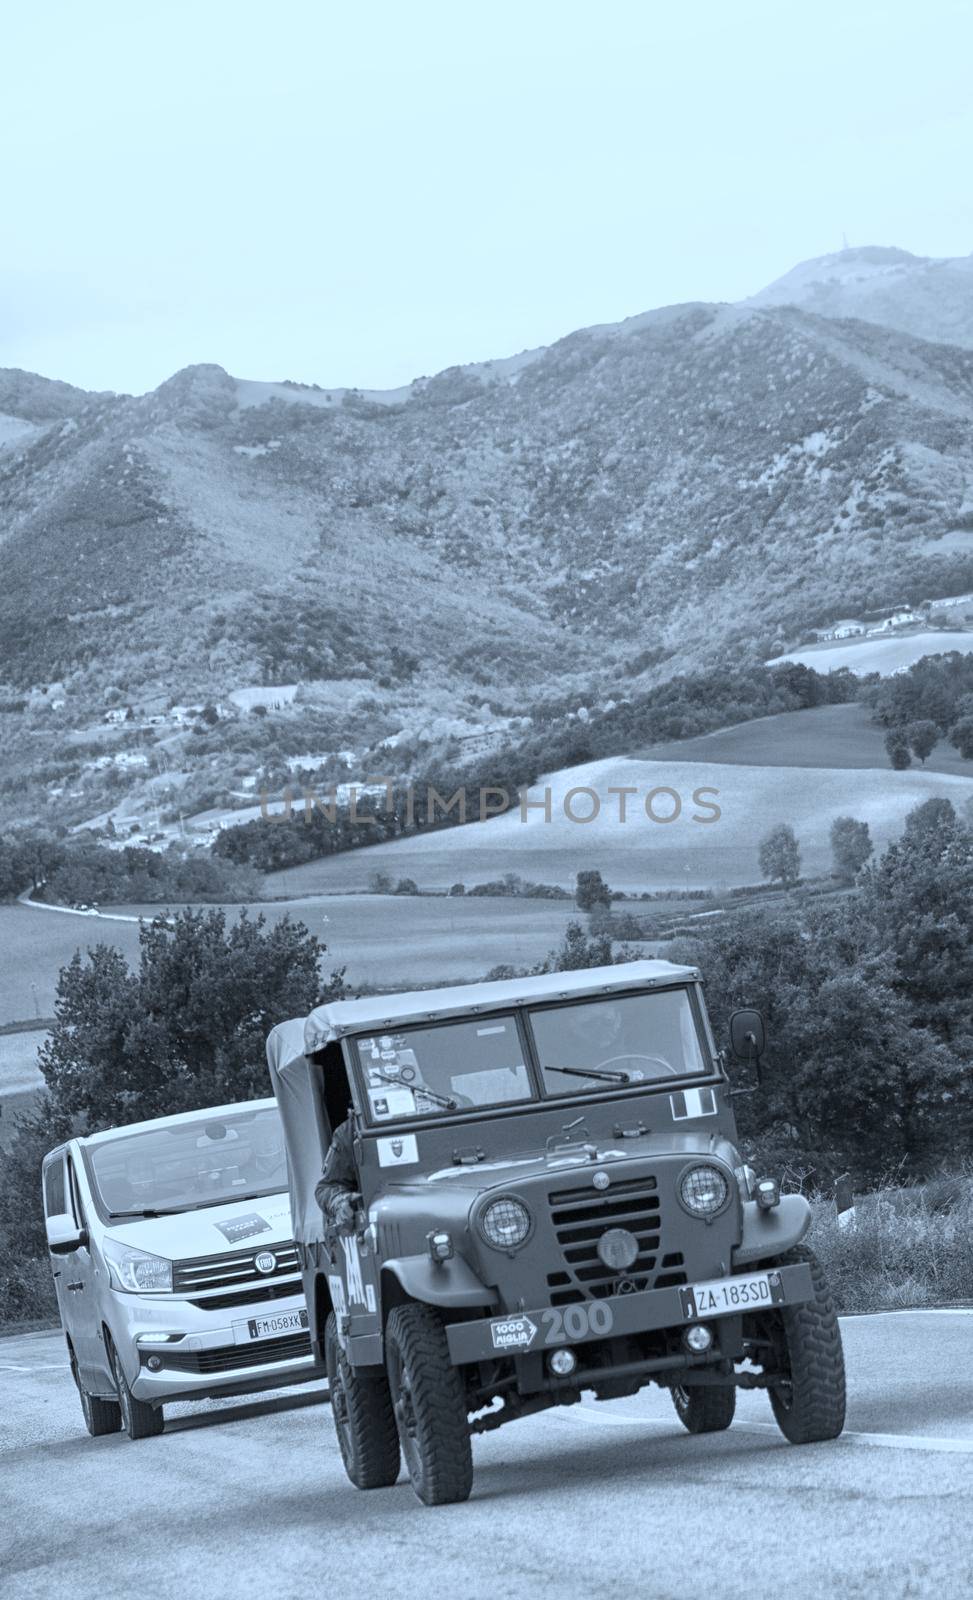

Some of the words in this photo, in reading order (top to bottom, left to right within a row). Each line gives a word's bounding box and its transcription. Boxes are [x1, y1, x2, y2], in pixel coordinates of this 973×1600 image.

[496, 1322, 524, 1334] 1000
[541, 1301, 613, 1344] 200
[497, 1332, 528, 1344] MIGLIA
